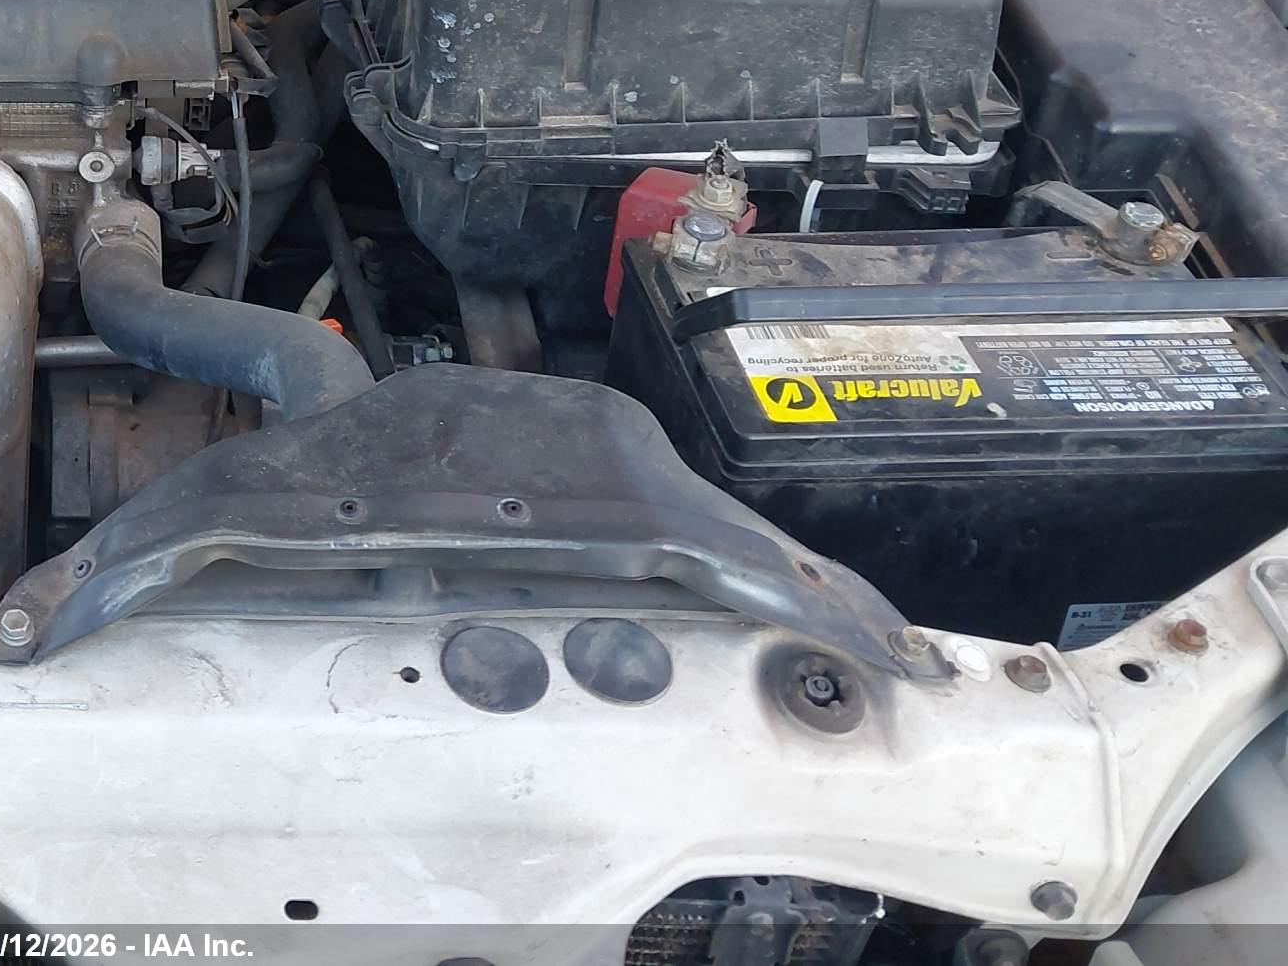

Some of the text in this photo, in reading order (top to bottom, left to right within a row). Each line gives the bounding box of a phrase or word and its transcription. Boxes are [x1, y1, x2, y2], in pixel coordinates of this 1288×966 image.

[747, 354, 931, 366] AutoZone for proper recycling
[786, 364, 938, 373] Return used batteries to
[833, 378, 983, 408] Valucraft
[1072, 400, 1203, 412] DANGER/POISON
